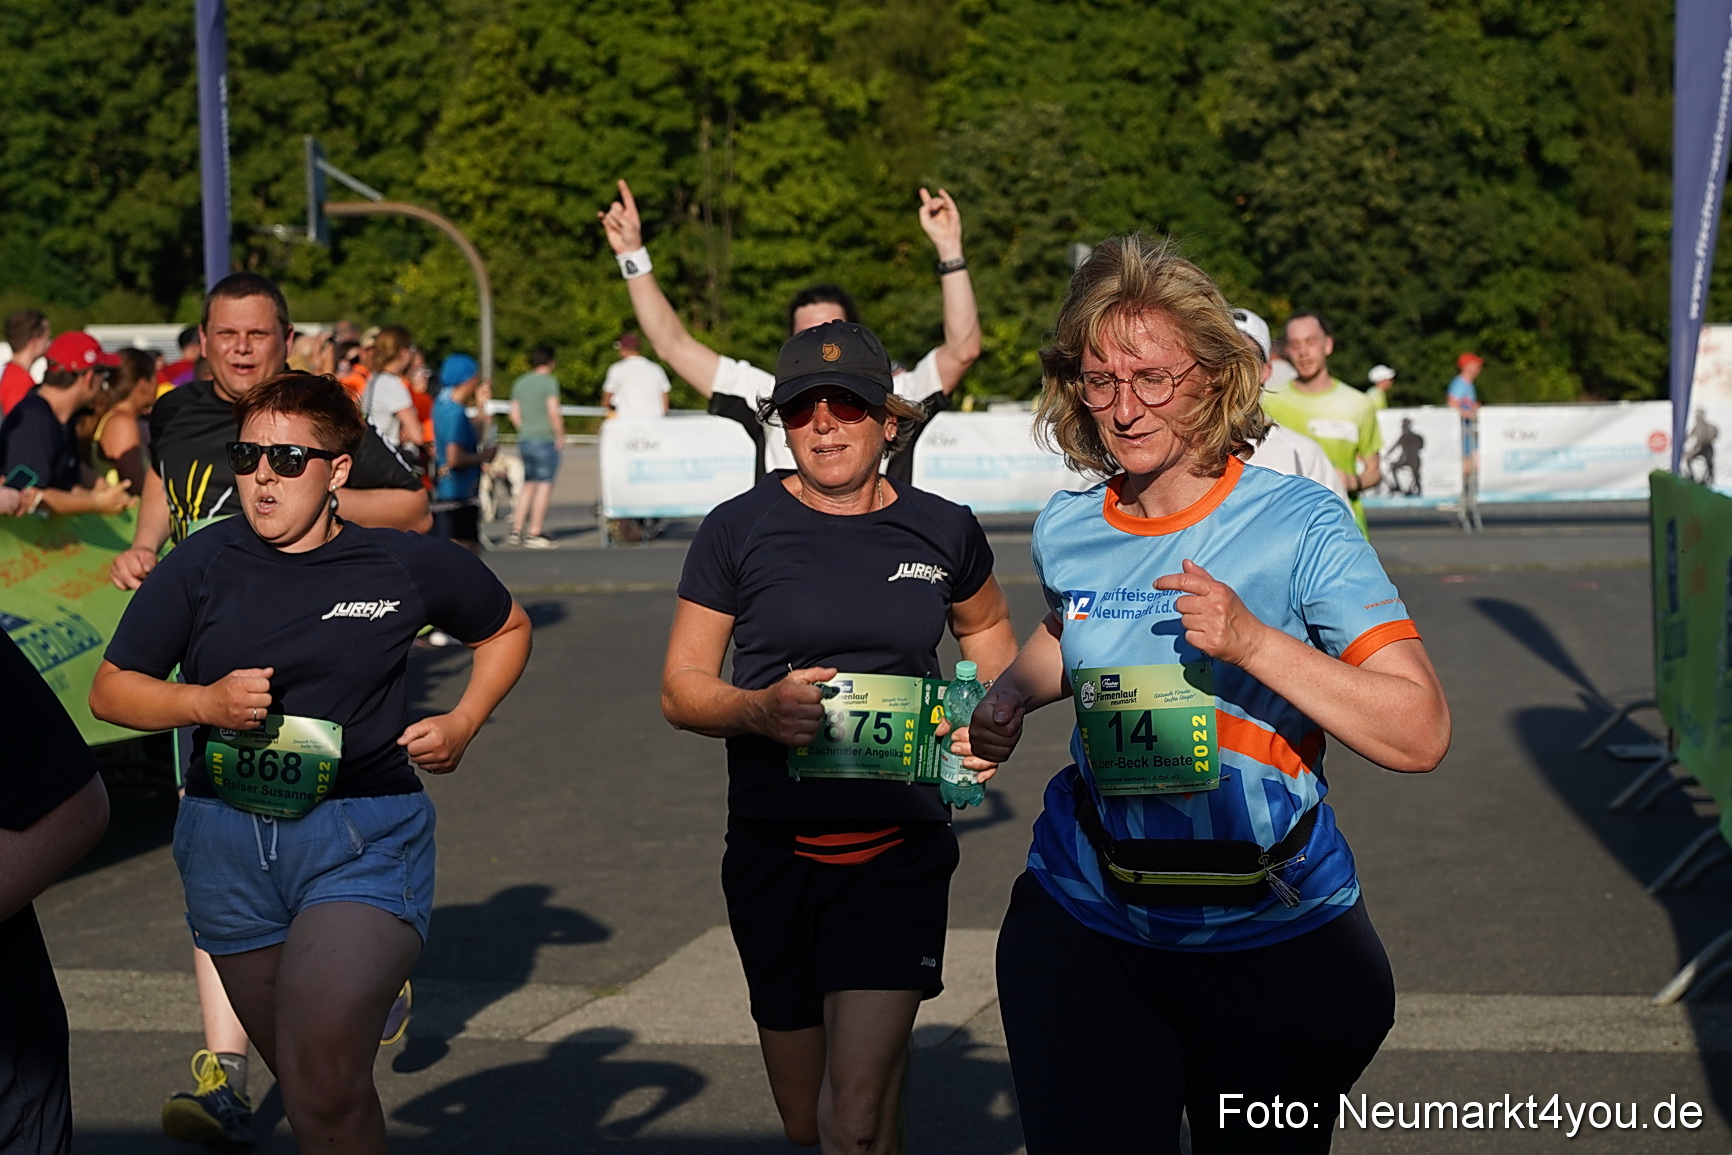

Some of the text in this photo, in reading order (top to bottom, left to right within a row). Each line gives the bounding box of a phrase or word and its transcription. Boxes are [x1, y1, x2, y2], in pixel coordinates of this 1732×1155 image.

[1096, 688, 1138, 701] Firmenlauf
[1110, 698, 1137, 706] neumarkt
[823, 709, 893, 745] 875
[903, 719, 915, 766] 2022
[1108, 710, 1158, 752] 14
[1192, 714, 1209, 773] 2022
[212, 752, 223, 786] RUN
[236, 746, 302, 785] 868
[808, 746, 862, 757] Zachmeier
[865, 747, 904, 759] Angelika
[1153, 754, 1193, 768] Beate
[222, 778, 315, 800] Reiser Susanne
